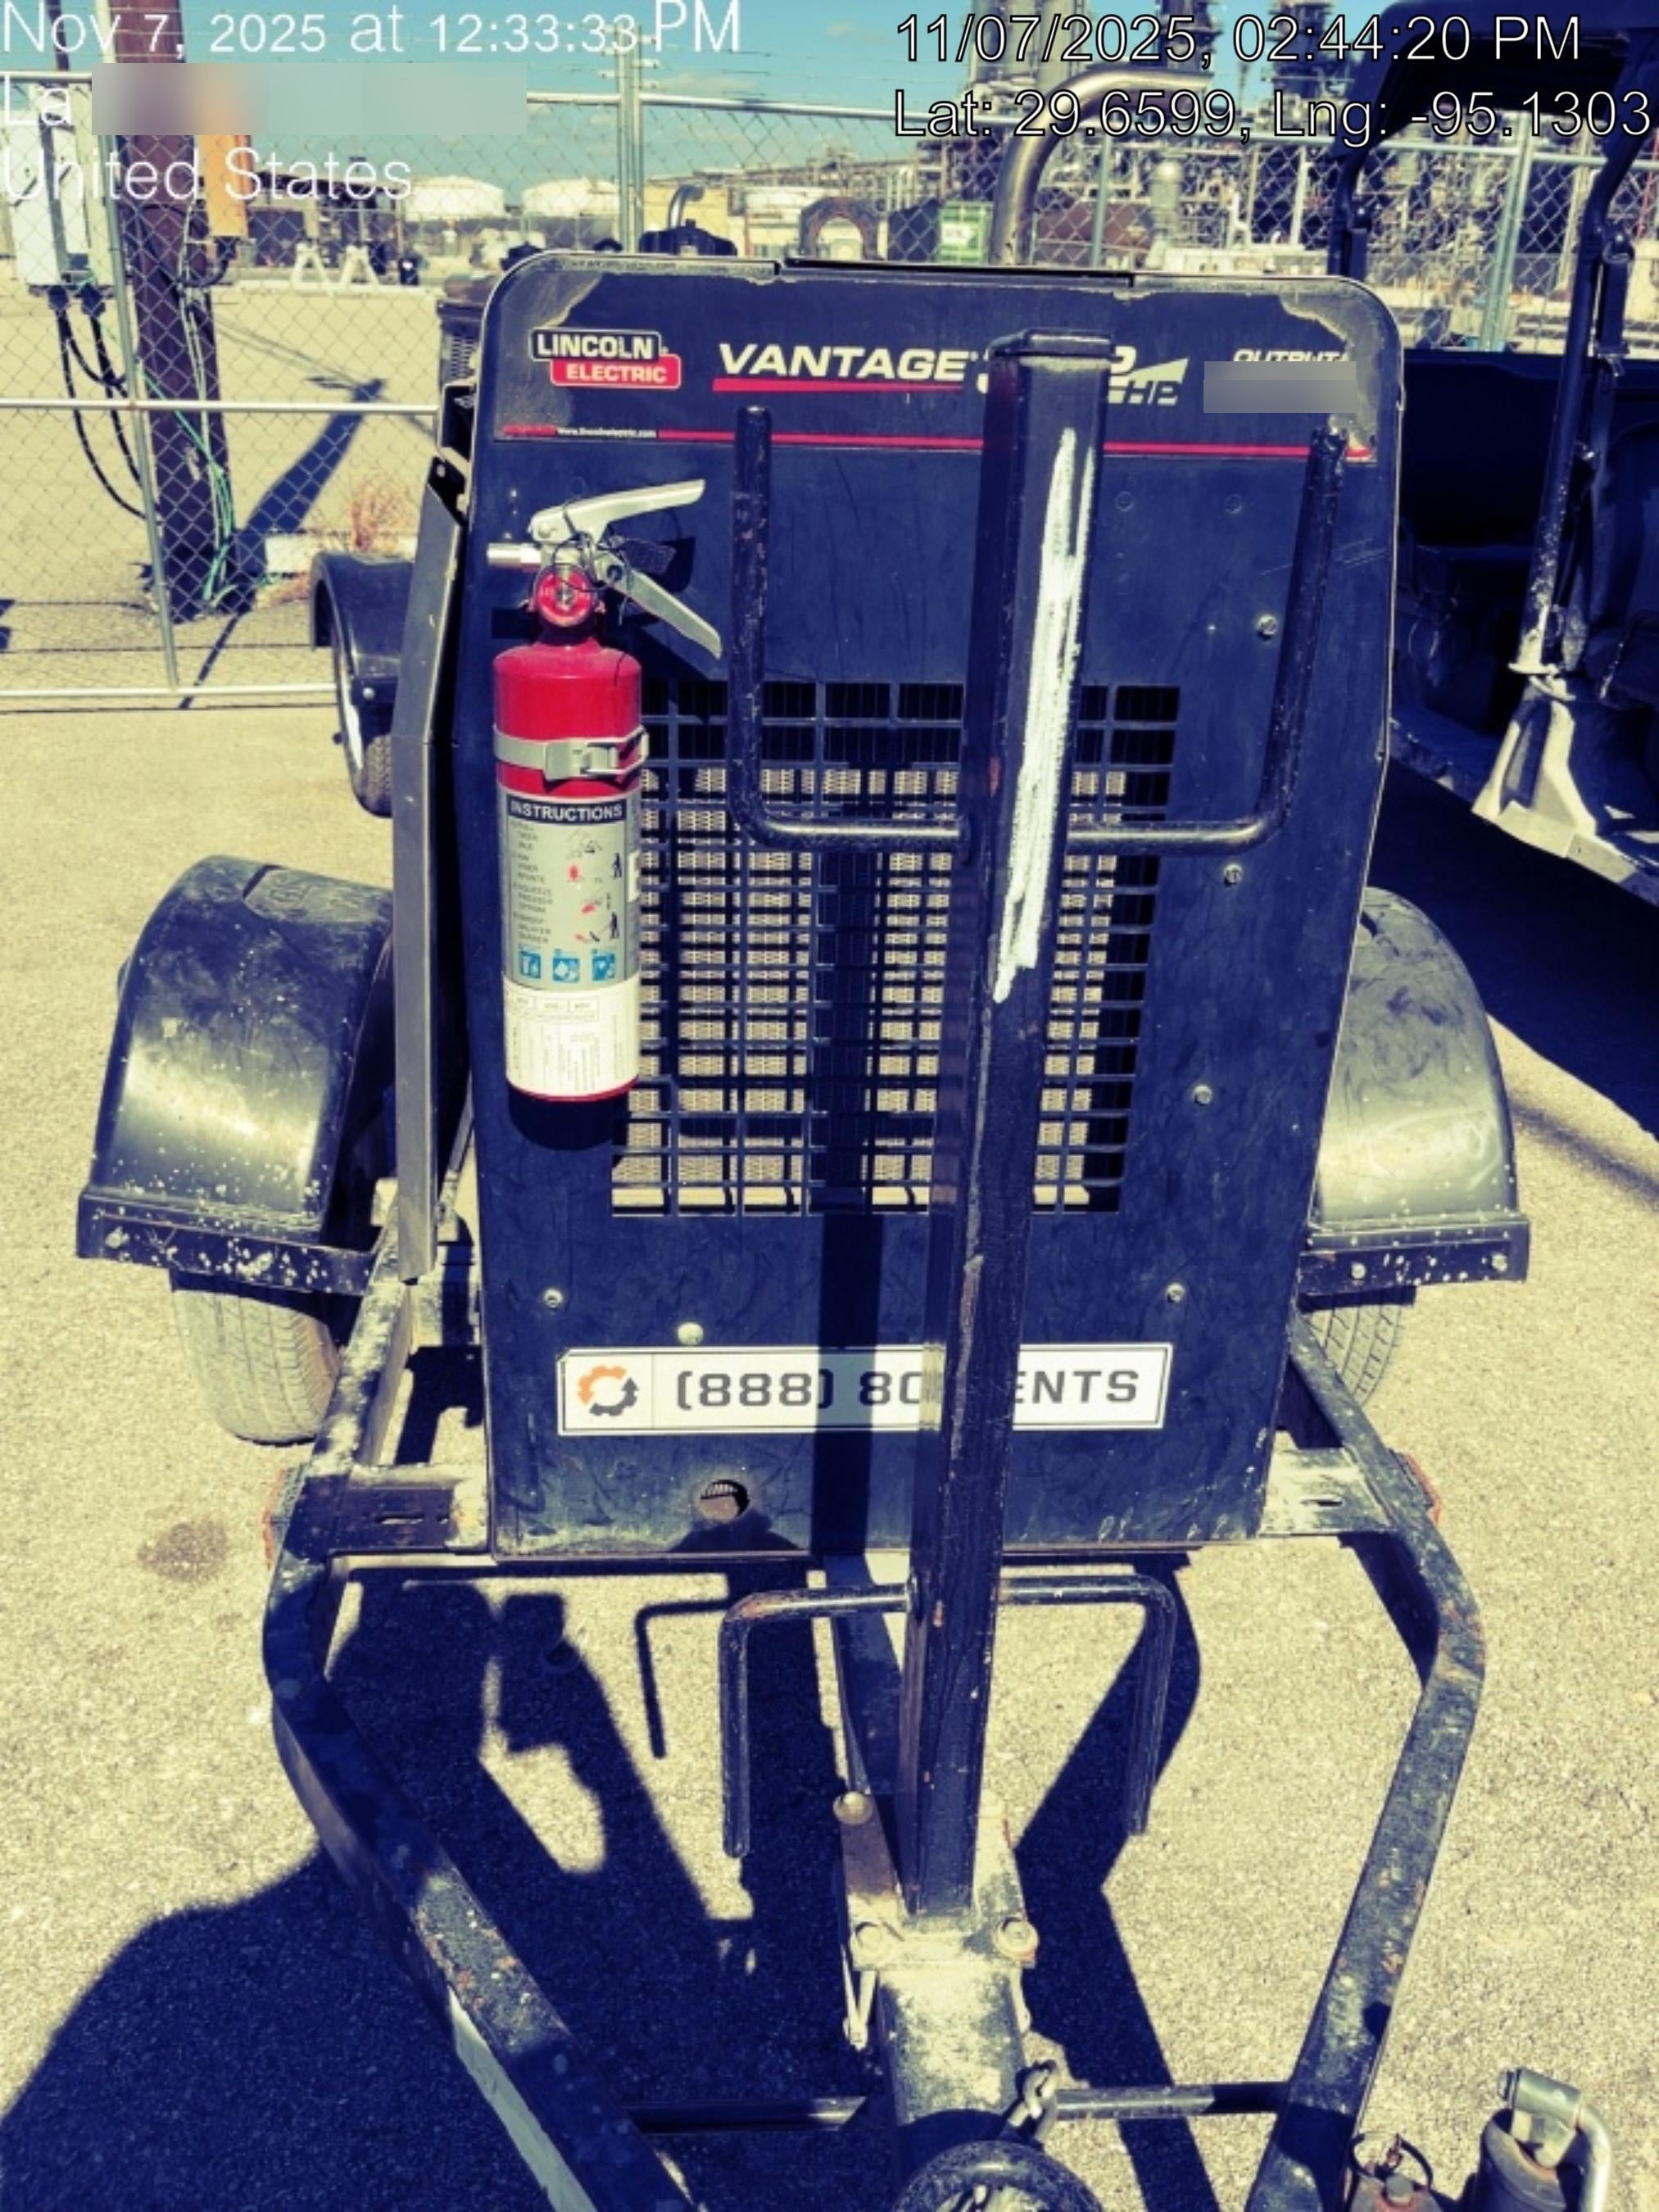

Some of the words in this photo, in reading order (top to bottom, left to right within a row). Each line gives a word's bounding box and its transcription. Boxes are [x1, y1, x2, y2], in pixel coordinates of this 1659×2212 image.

[537, 333, 653, 360] LINCOLN
[565, 363, 667, 383] ELECTRIC
[718, 342, 970, 382] VANTAGE
[510, 800, 623, 822] INSTRUCTIONS
[677, 1369, 835, 1411] (888)
